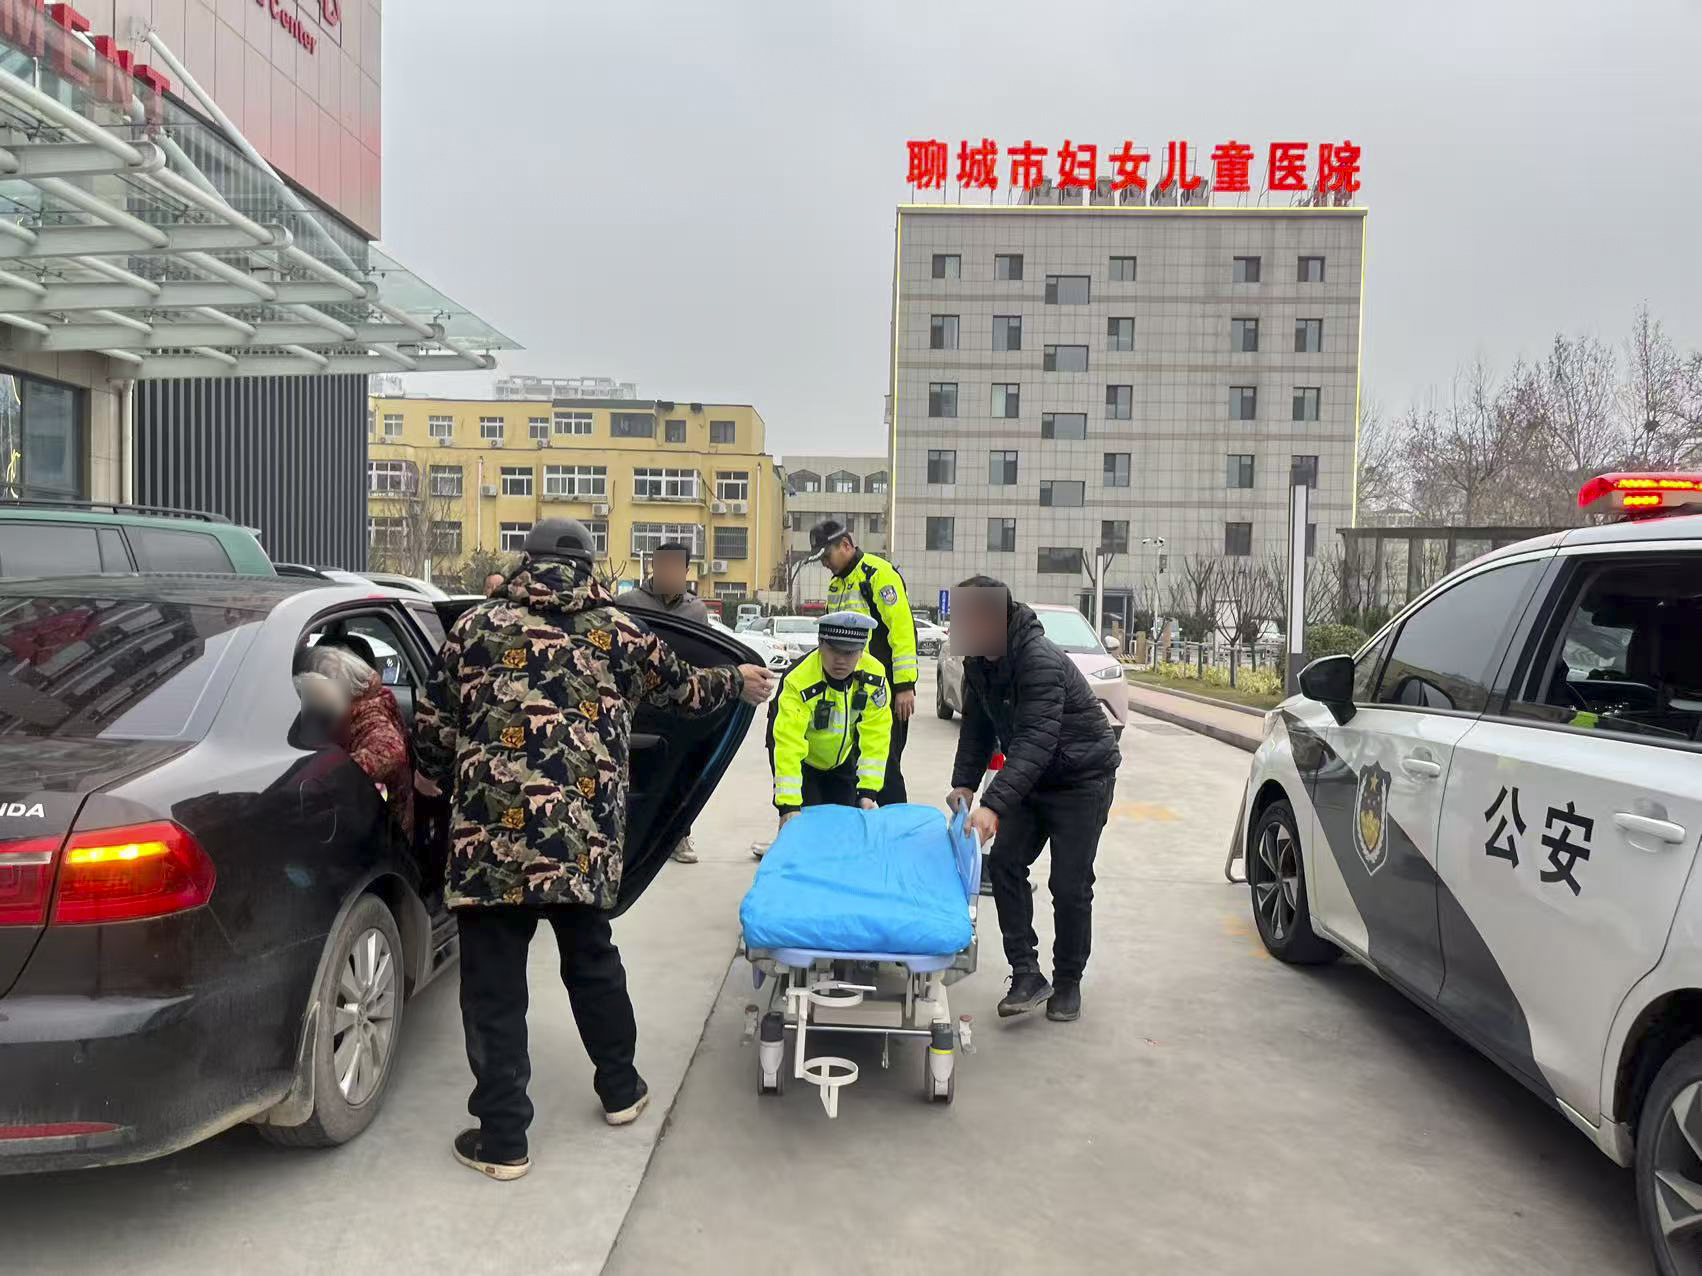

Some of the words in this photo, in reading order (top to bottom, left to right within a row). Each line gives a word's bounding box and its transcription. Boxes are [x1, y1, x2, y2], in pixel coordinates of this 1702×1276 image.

[905, 137, 1361, 194] 聊城市妇女儿童医院
[1484, 785, 1595, 896] 公安
